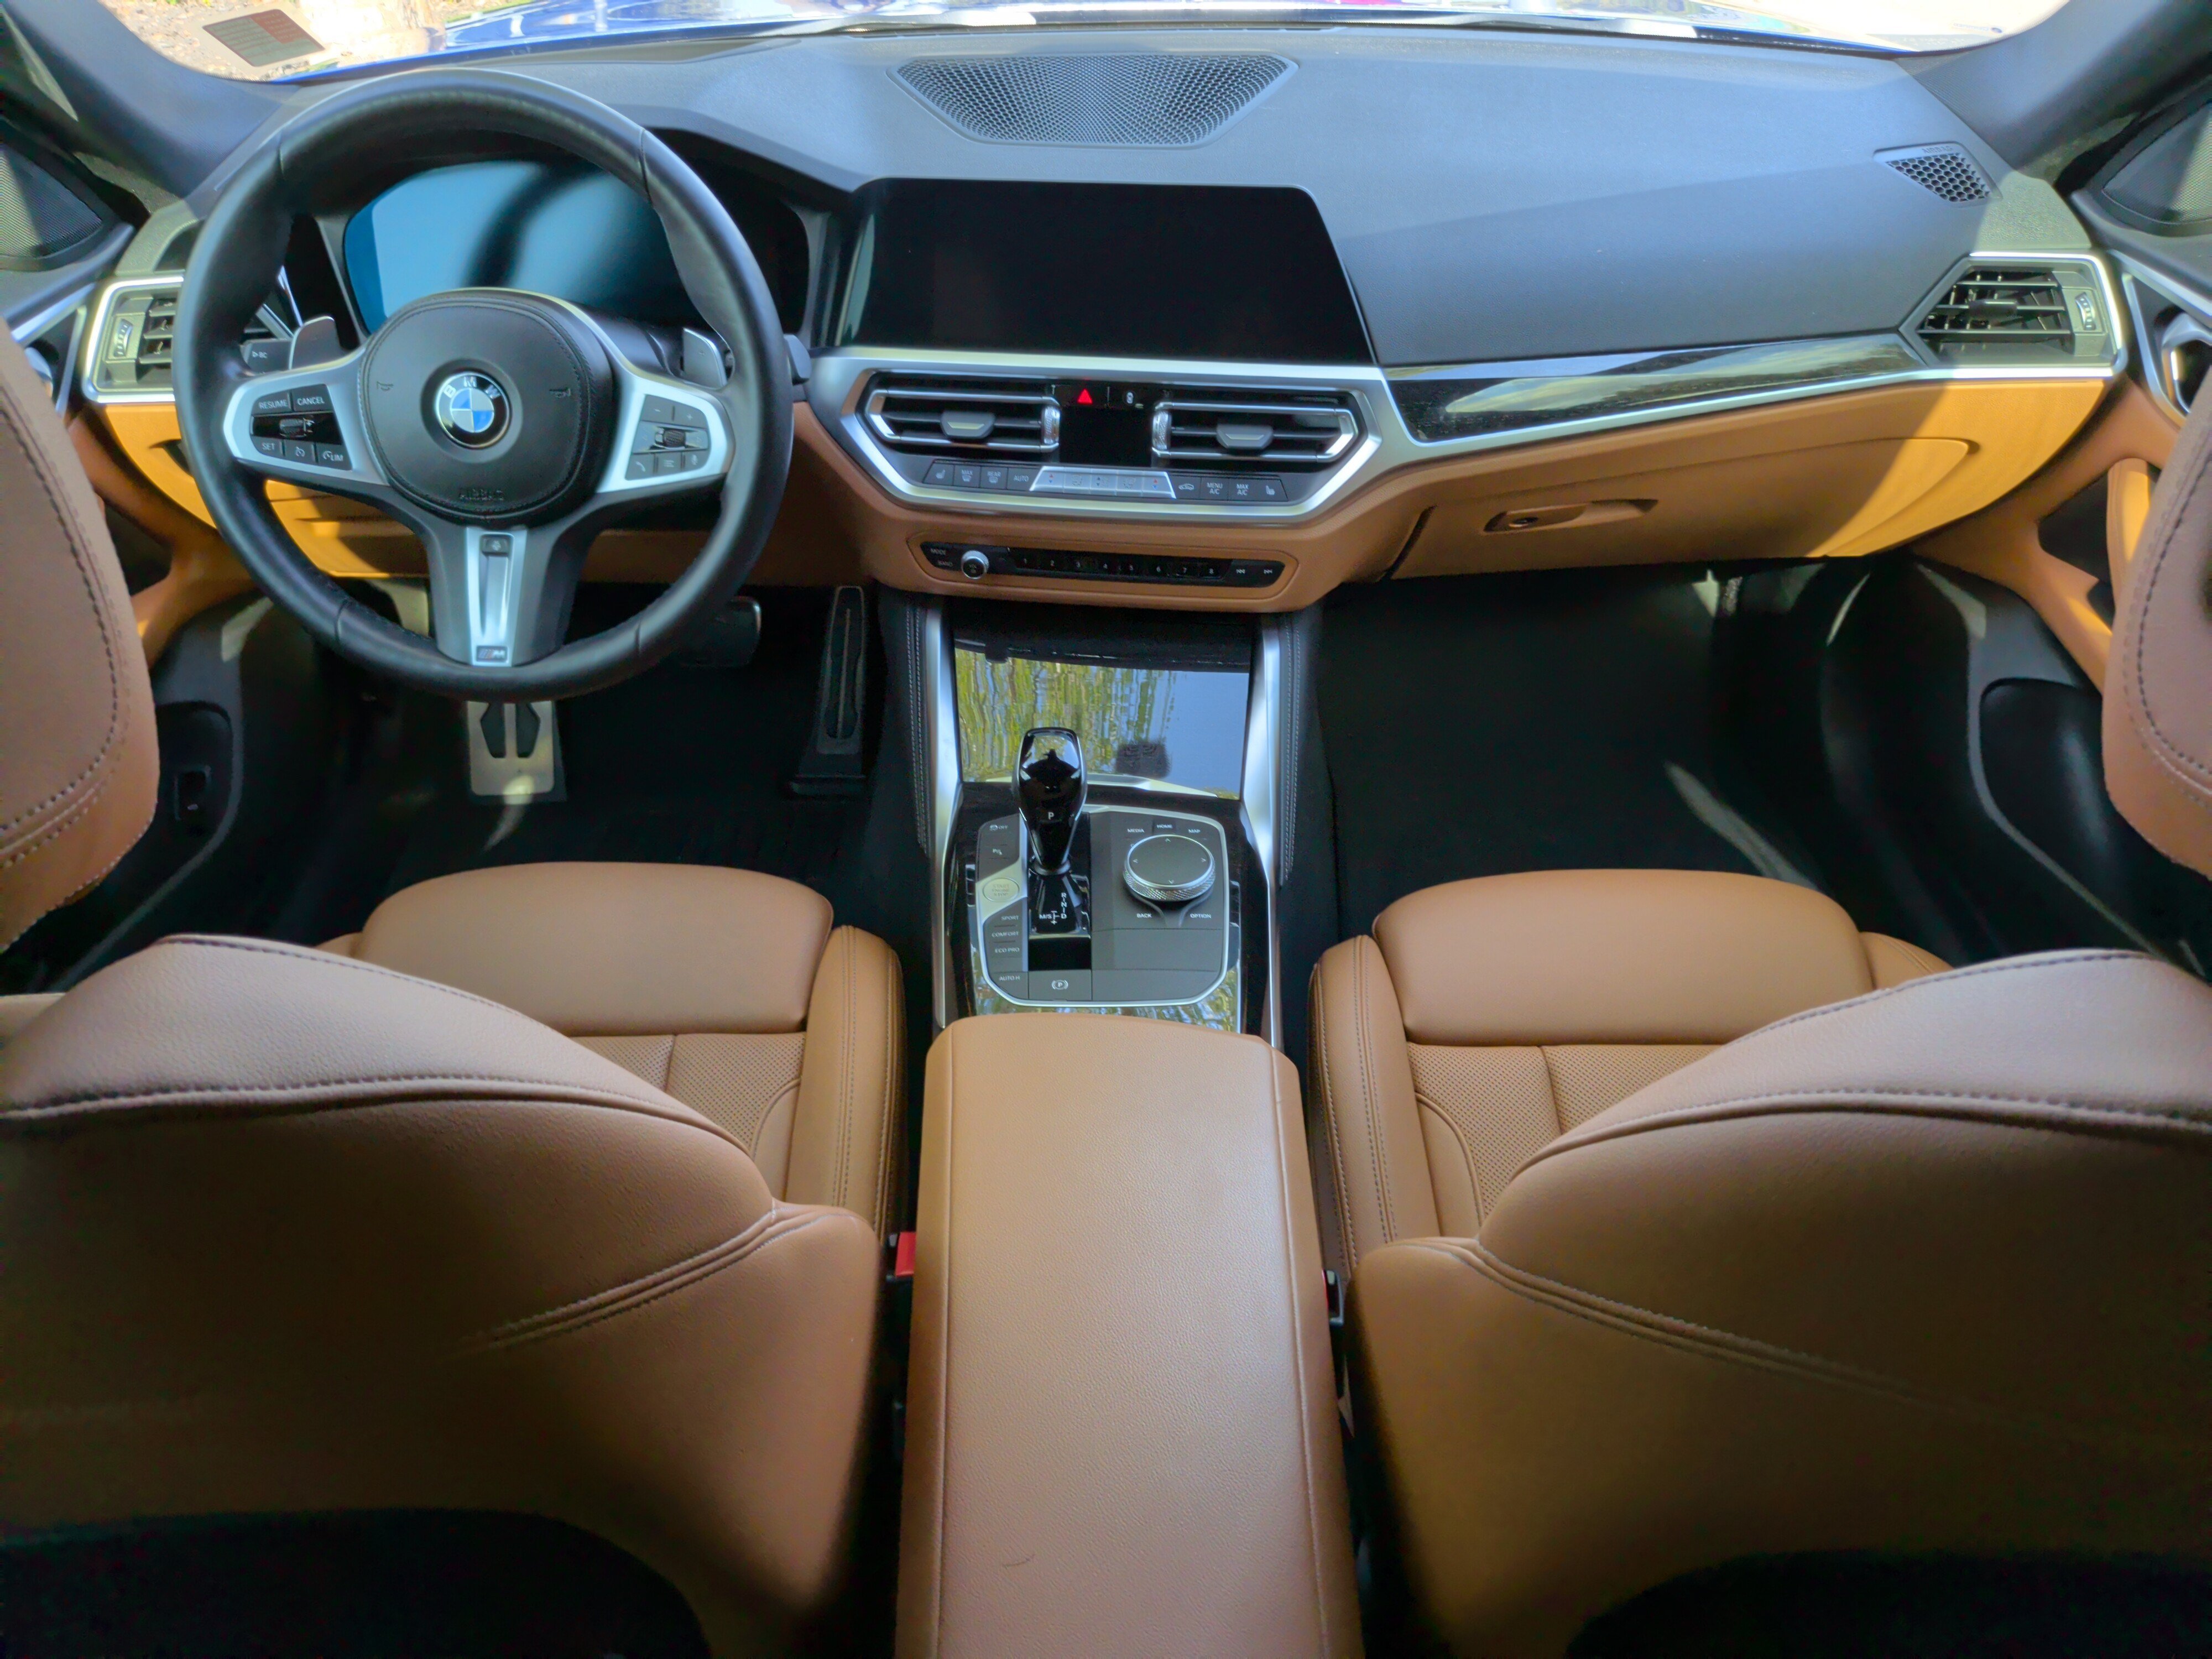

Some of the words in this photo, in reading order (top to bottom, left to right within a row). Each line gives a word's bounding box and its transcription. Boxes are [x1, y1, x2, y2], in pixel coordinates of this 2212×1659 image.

[443, 376, 500, 399] BMW
[259, 399, 288, 409] RESUME
[297, 397, 325, 405] CANCEL
